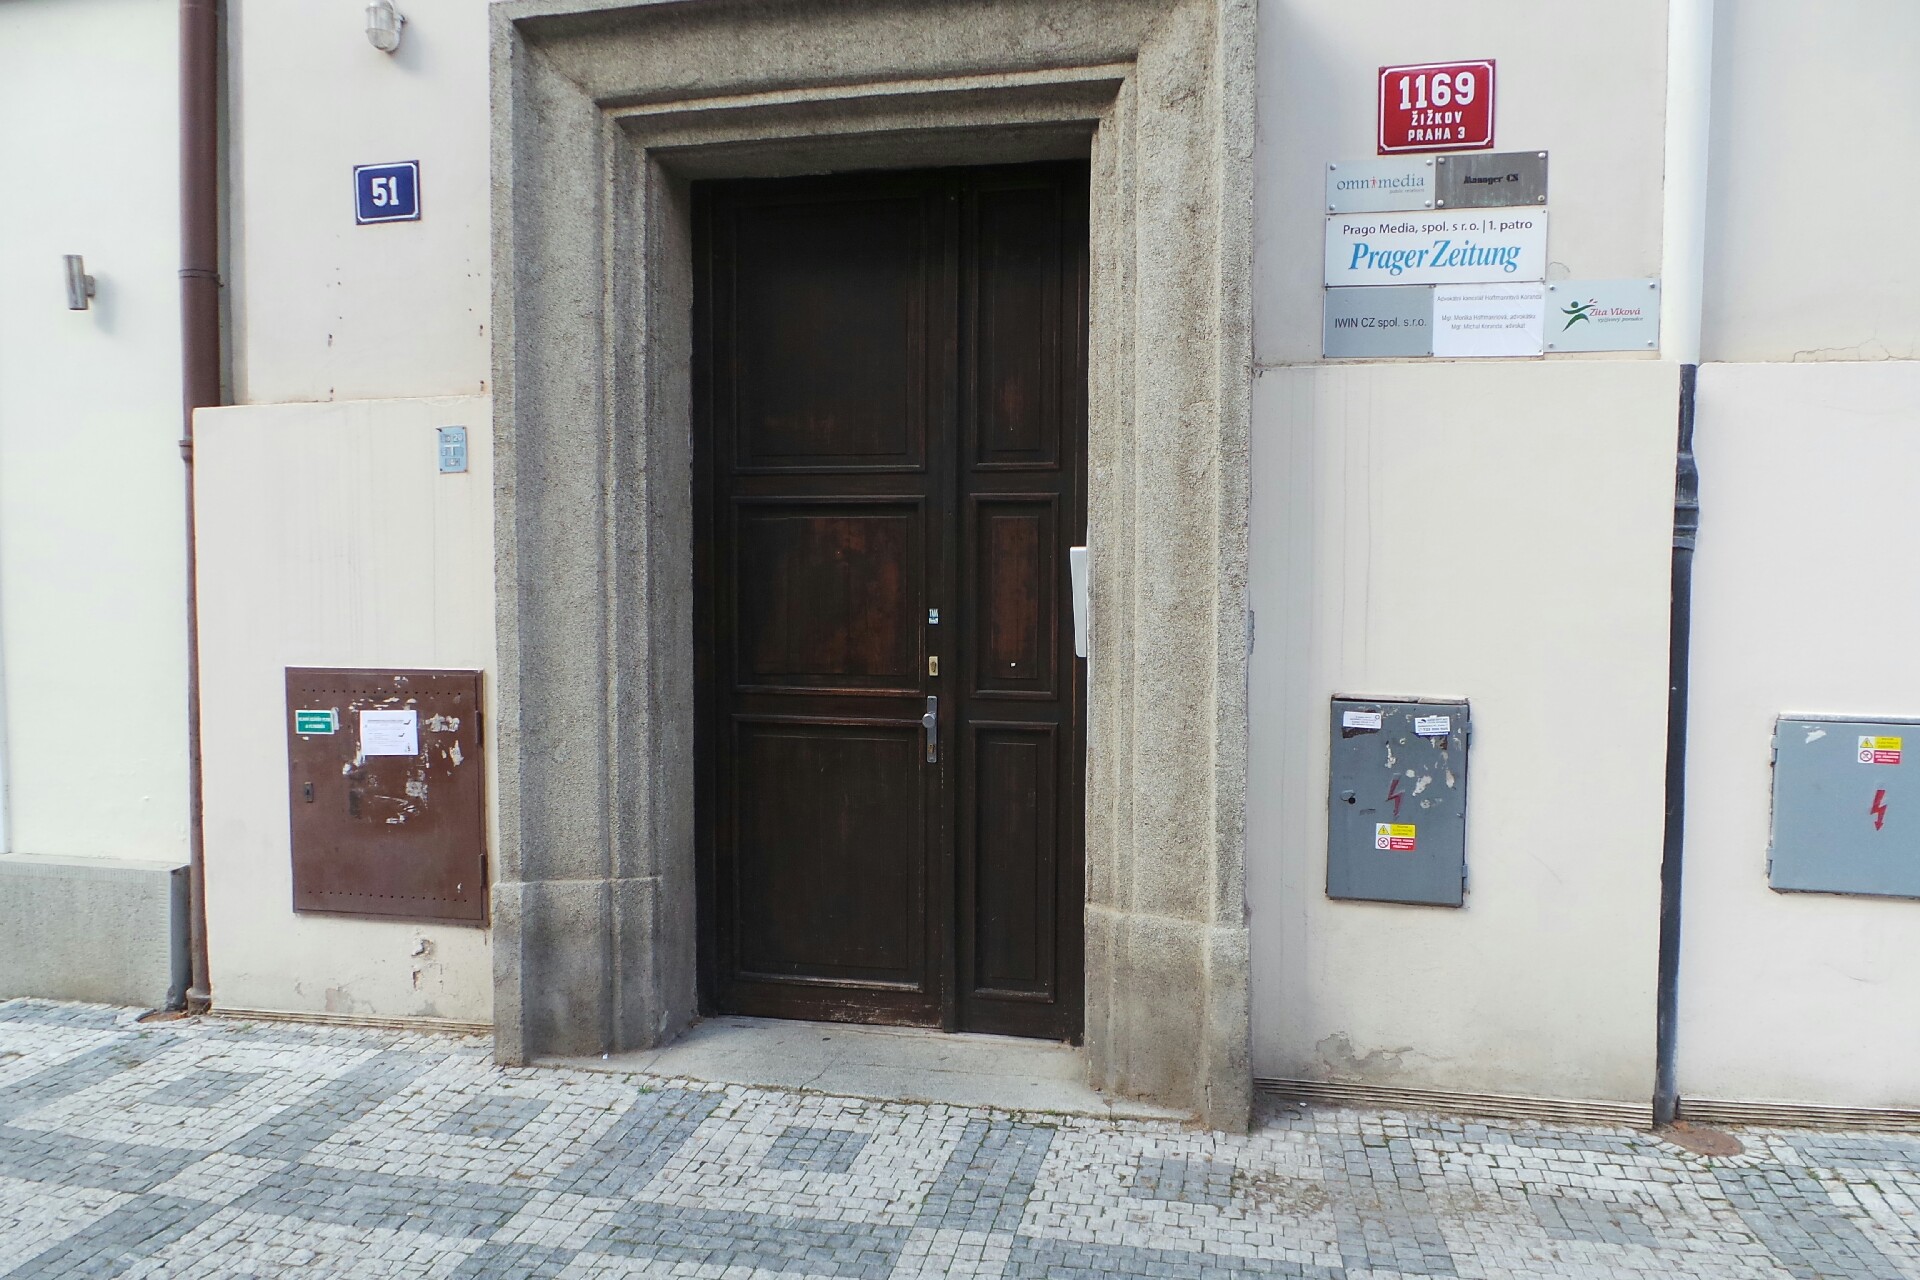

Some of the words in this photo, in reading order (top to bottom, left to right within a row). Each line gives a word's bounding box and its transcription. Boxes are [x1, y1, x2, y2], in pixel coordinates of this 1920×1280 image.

[1399, 71, 1475, 110] 1169
[1411, 109, 1463, 126] ŽIŽKOV
[1408, 127, 1451, 141] PRAHA
[1457, 126, 1466, 139] 3
[1336, 174, 1425, 190] omnimedia
[371, 176, 400, 207] 51
[1343, 224, 1376, 237] Prago
[1379, 222, 1418, 234] Media,
[1421, 221, 1449, 235] spol.
[1452, 223, 1458, 231] s
[1489, 220, 1496, 231] 1.
[1500, 220, 1533, 233] patro
[1348, 242, 1429, 276] Prager
[1429, 239, 1521, 273] Zeitung
[1589, 308, 1607, 316] Zita
[1334, 317, 1358, 328] IWIN
[1360, 317, 1375, 328] CZ
[1377, 316, 1400, 330] spol.
[1403, 318, 1427, 327] s.r.o.
